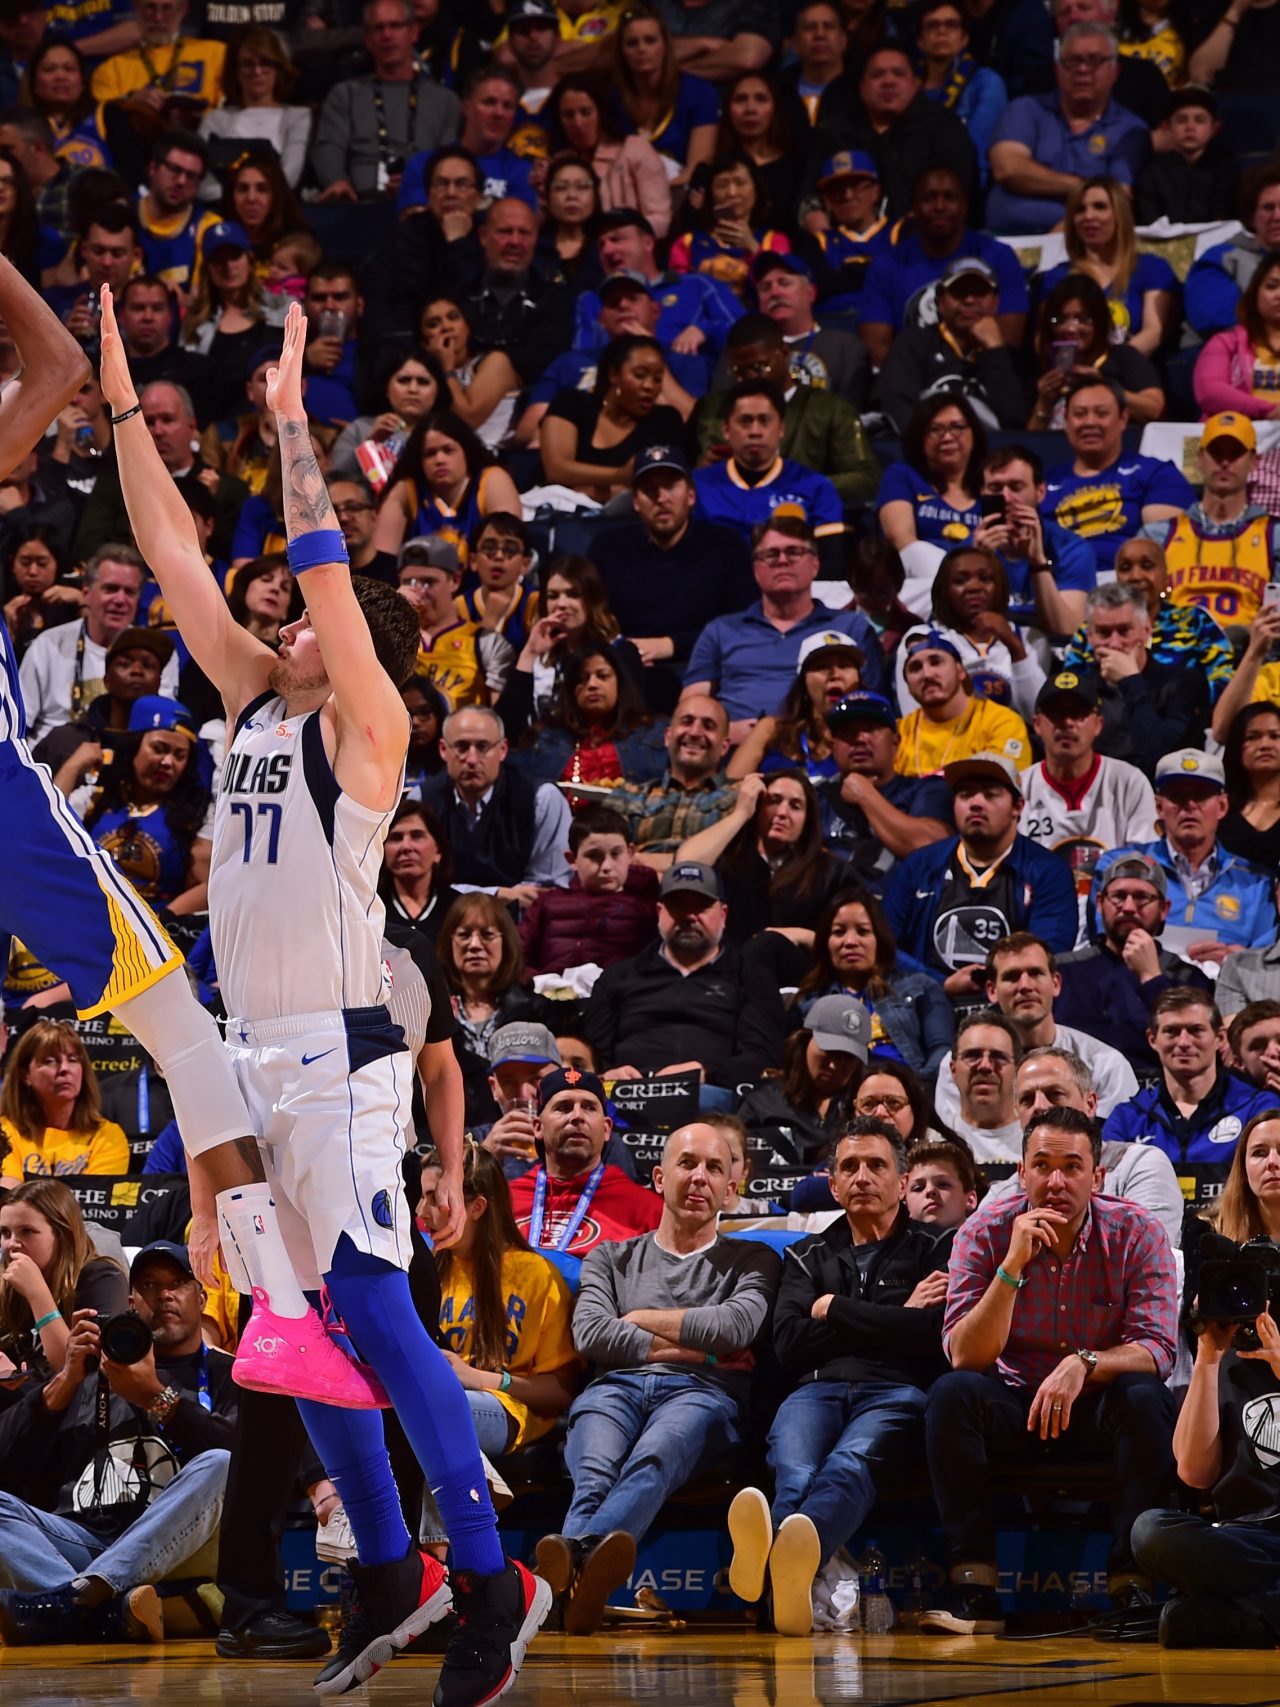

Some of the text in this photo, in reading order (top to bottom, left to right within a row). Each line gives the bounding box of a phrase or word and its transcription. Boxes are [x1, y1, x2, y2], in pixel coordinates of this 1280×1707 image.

[230, 802, 284, 865] 77
[1028, 817, 1054, 838] 23
[973, 917, 1002, 941] 35
[79, 1035, 115, 1047] ASINO
[92, 1055, 141, 1072] creek
[615, 1081, 692, 1099] CREEK
[81, 1208, 119, 1221] ASINO
